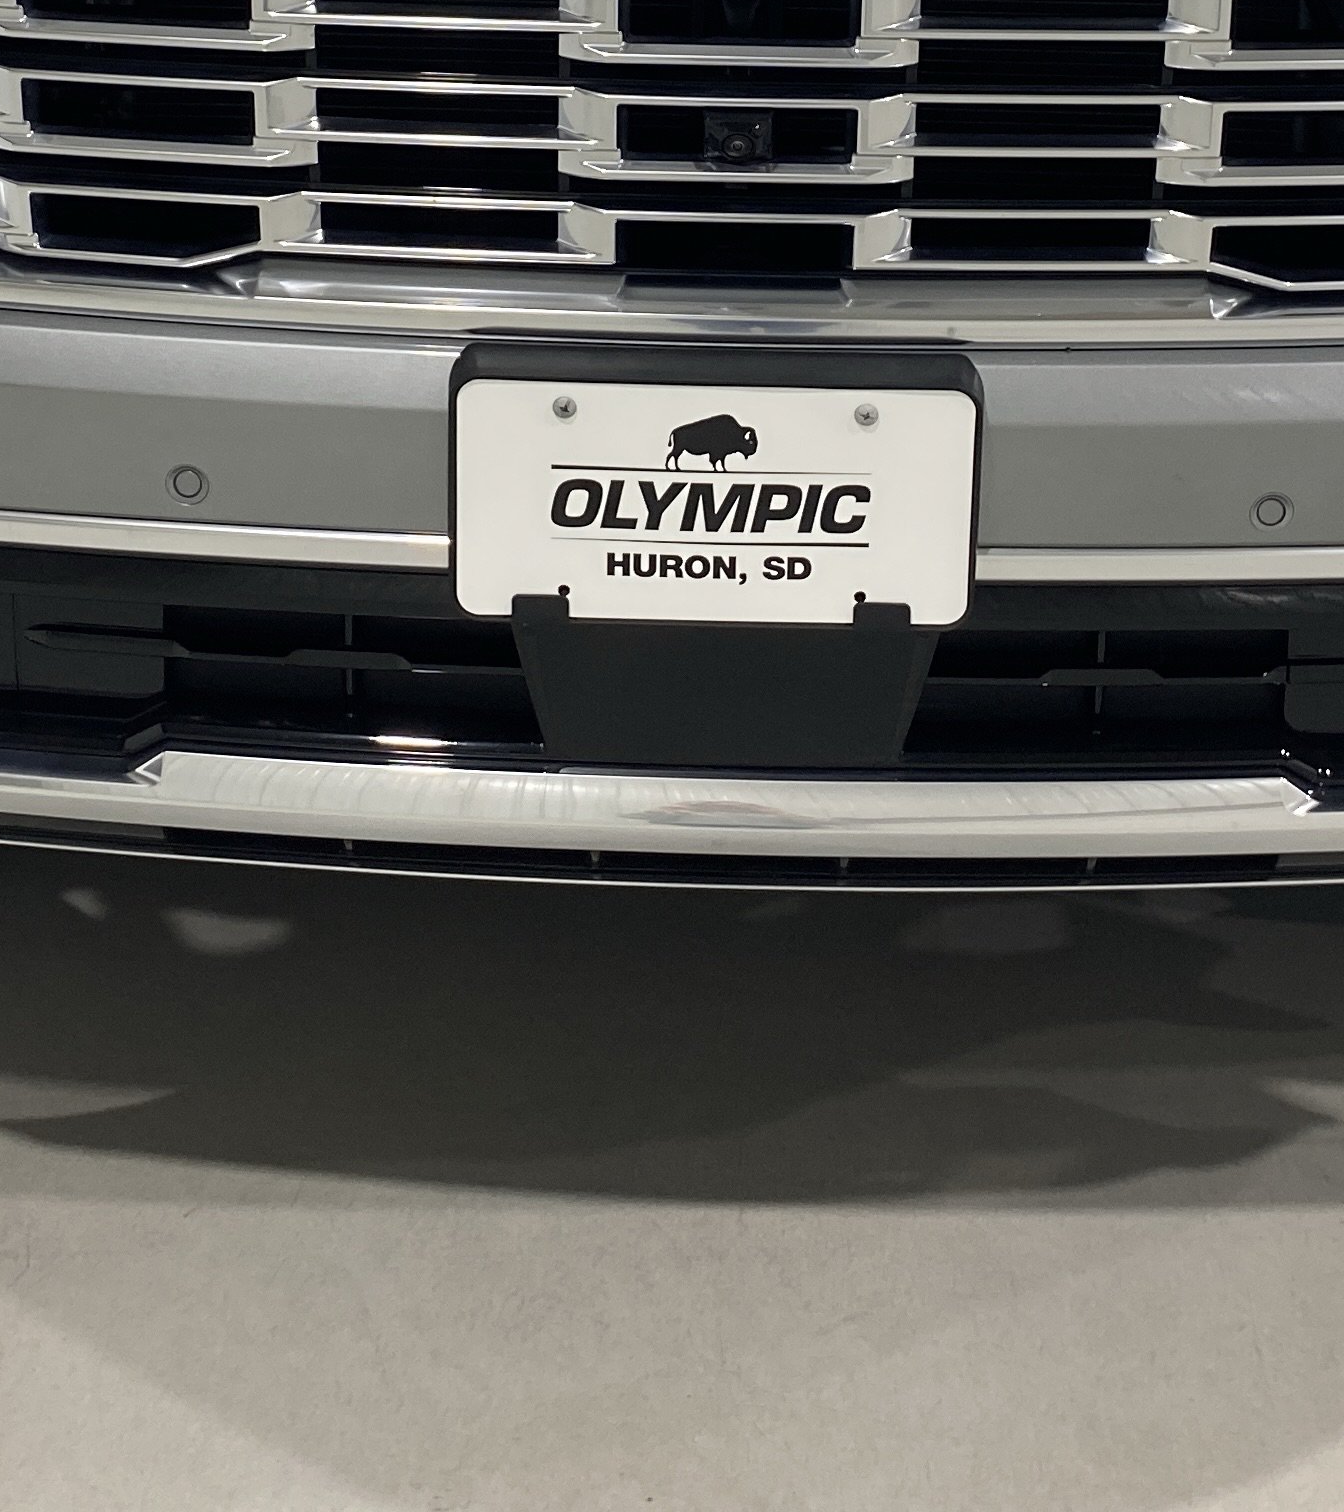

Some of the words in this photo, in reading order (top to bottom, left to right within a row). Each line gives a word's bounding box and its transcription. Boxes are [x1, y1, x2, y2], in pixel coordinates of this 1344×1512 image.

[549, 478, 871, 535] OLYMPIC
[606, 552, 748, 585] HURON,
[762, 557, 813, 581] SD
